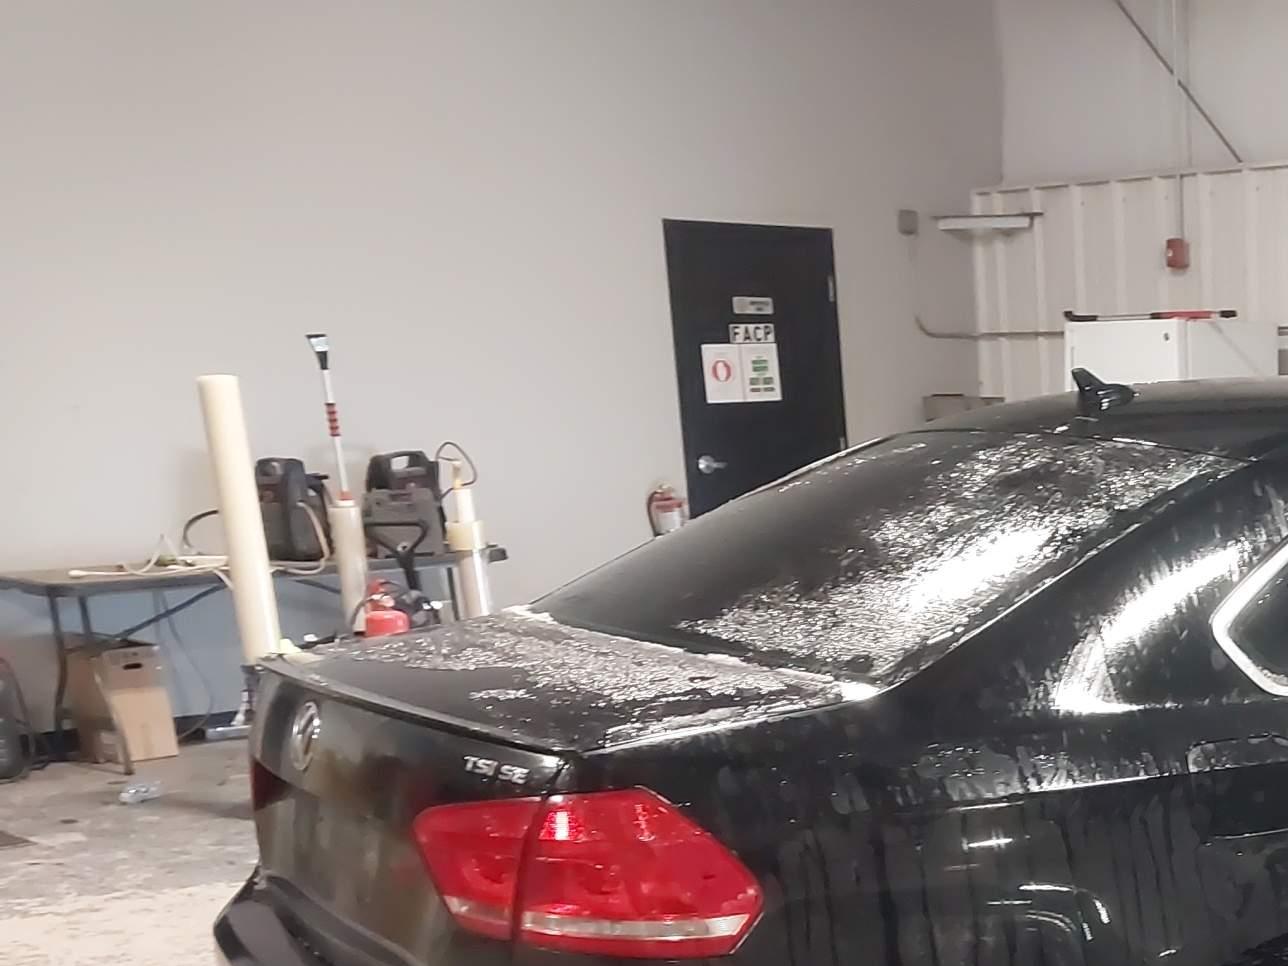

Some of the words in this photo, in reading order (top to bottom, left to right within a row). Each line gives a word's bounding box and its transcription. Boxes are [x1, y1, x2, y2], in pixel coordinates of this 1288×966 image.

[731, 325, 773, 342] FACP
[463, 756, 499, 776] TSI
[499, 765, 530, 784] SE
